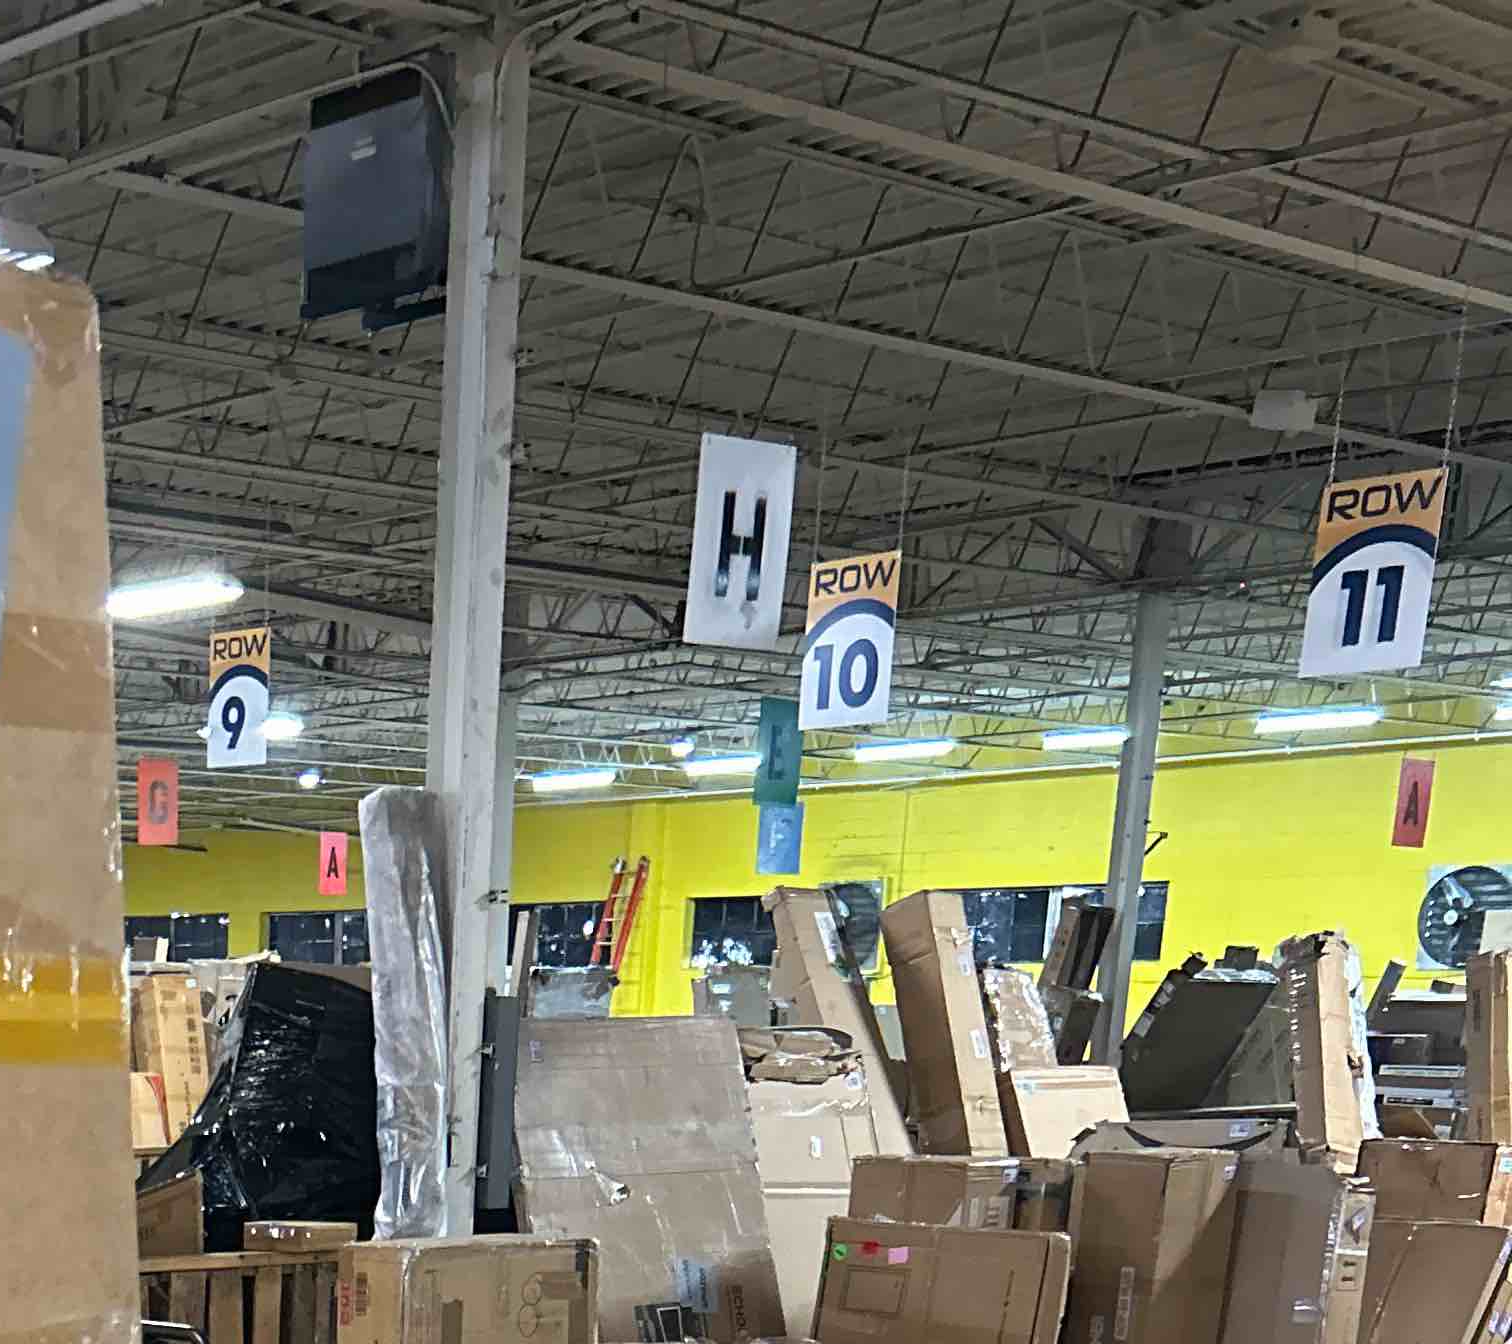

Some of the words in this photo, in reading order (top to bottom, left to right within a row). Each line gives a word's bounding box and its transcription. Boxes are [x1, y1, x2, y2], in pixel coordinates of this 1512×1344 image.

[1326, 475, 1443, 522] ROW
[715, 491, 767, 600] H
[815, 559, 897, 598] ROW
[1341, 566, 1404, 647] 11
[213, 634, 267, 660] ROW
[814, 639, 878, 709] 10
[222, 696, 245, 749] 9
[150, 780, 168, 824] G
[1404, 782, 1418, 825] A
[327, 847, 339, 879] A
